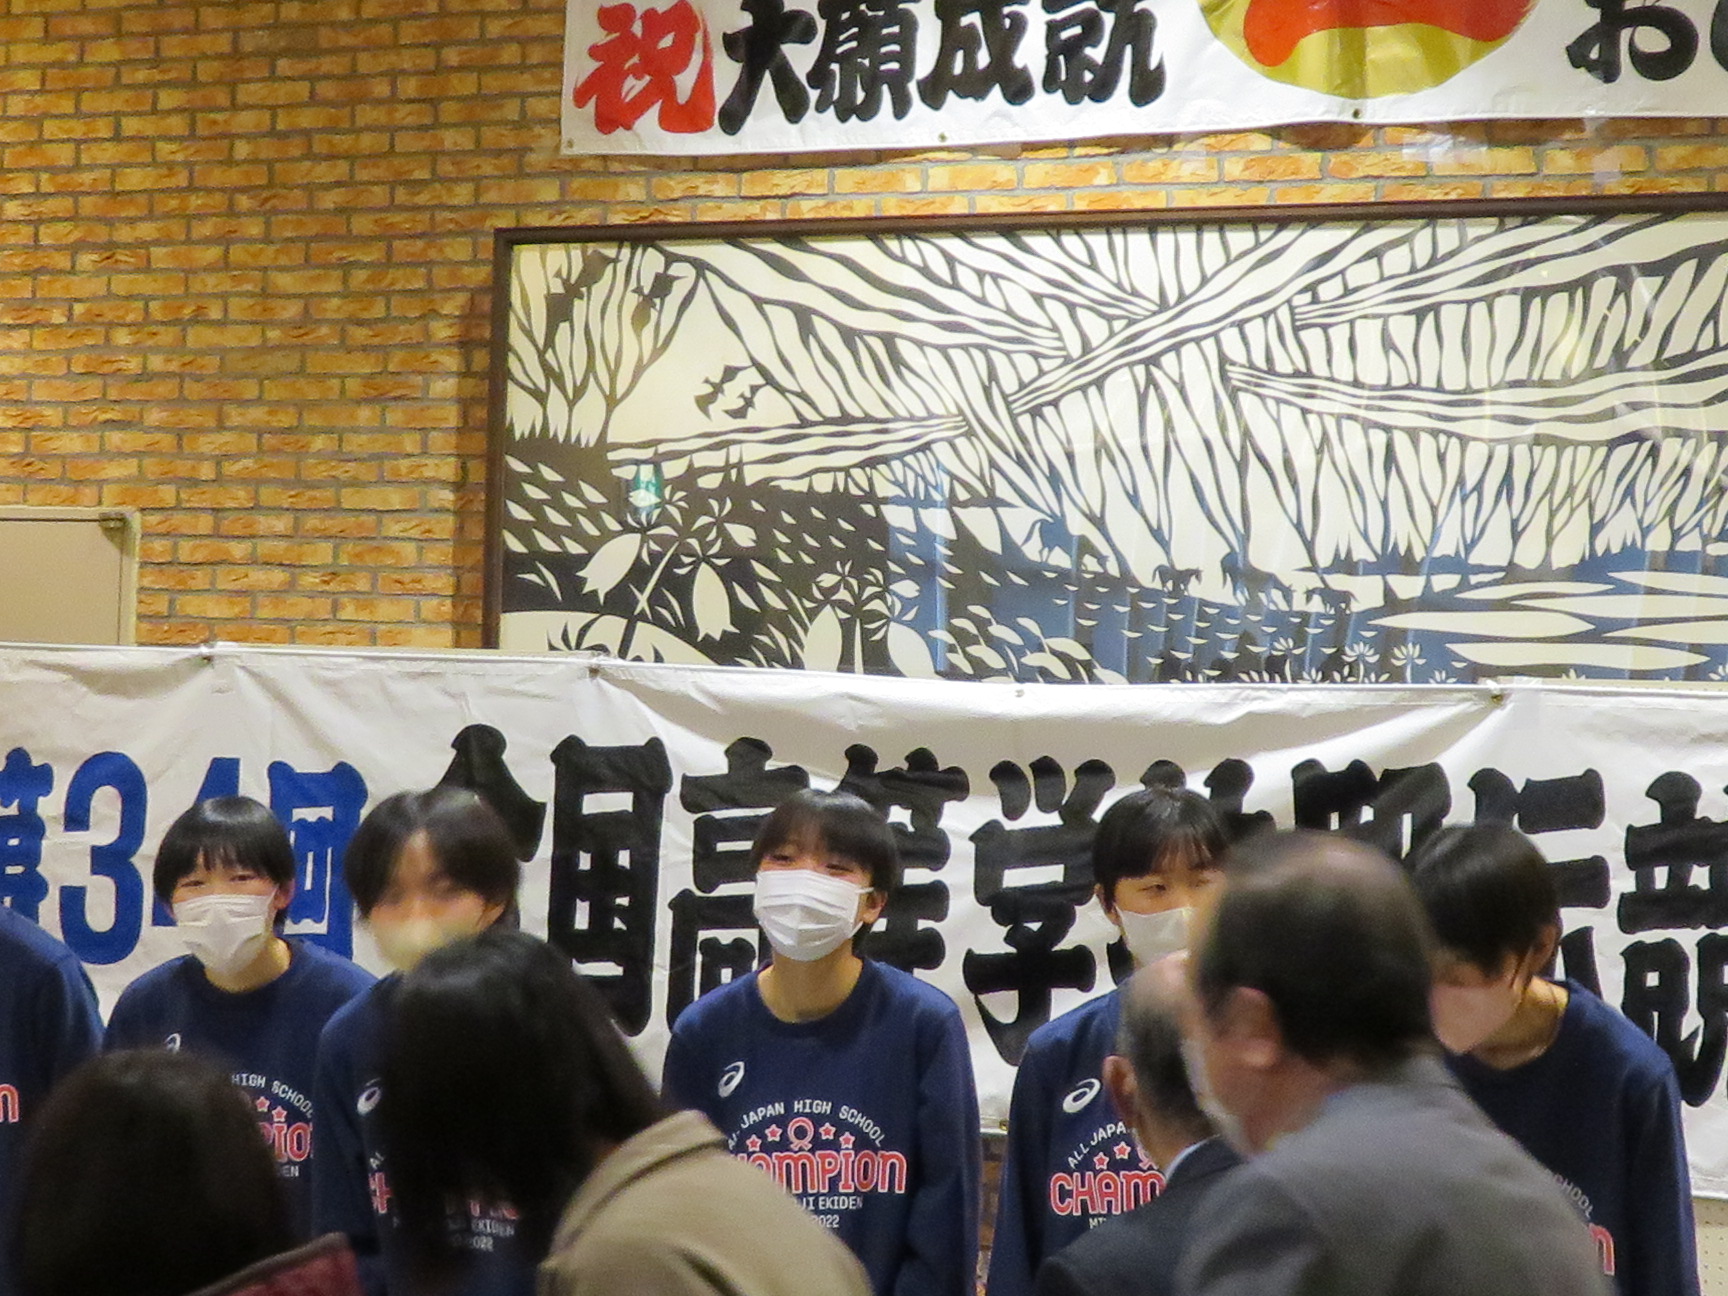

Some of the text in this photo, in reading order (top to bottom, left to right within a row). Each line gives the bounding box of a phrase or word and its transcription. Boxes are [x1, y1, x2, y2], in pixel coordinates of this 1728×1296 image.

[573, 0, 716, 135] 祝
[232, 1074, 314, 1118] HIGH SCHOOL
[740, 1102, 785, 1129] JAPAN
[793, 1099, 832, 1115] HIGH
[838, 1105, 886, 1147] SCHOOL
[1067, 1121, 1127, 1170] ALL JAPA
[737, 1150, 907, 1194] AMPION
[1050, 1170, 1167, 1216] CHAM
[1554, 1174, 1594, 1220] HOOL
